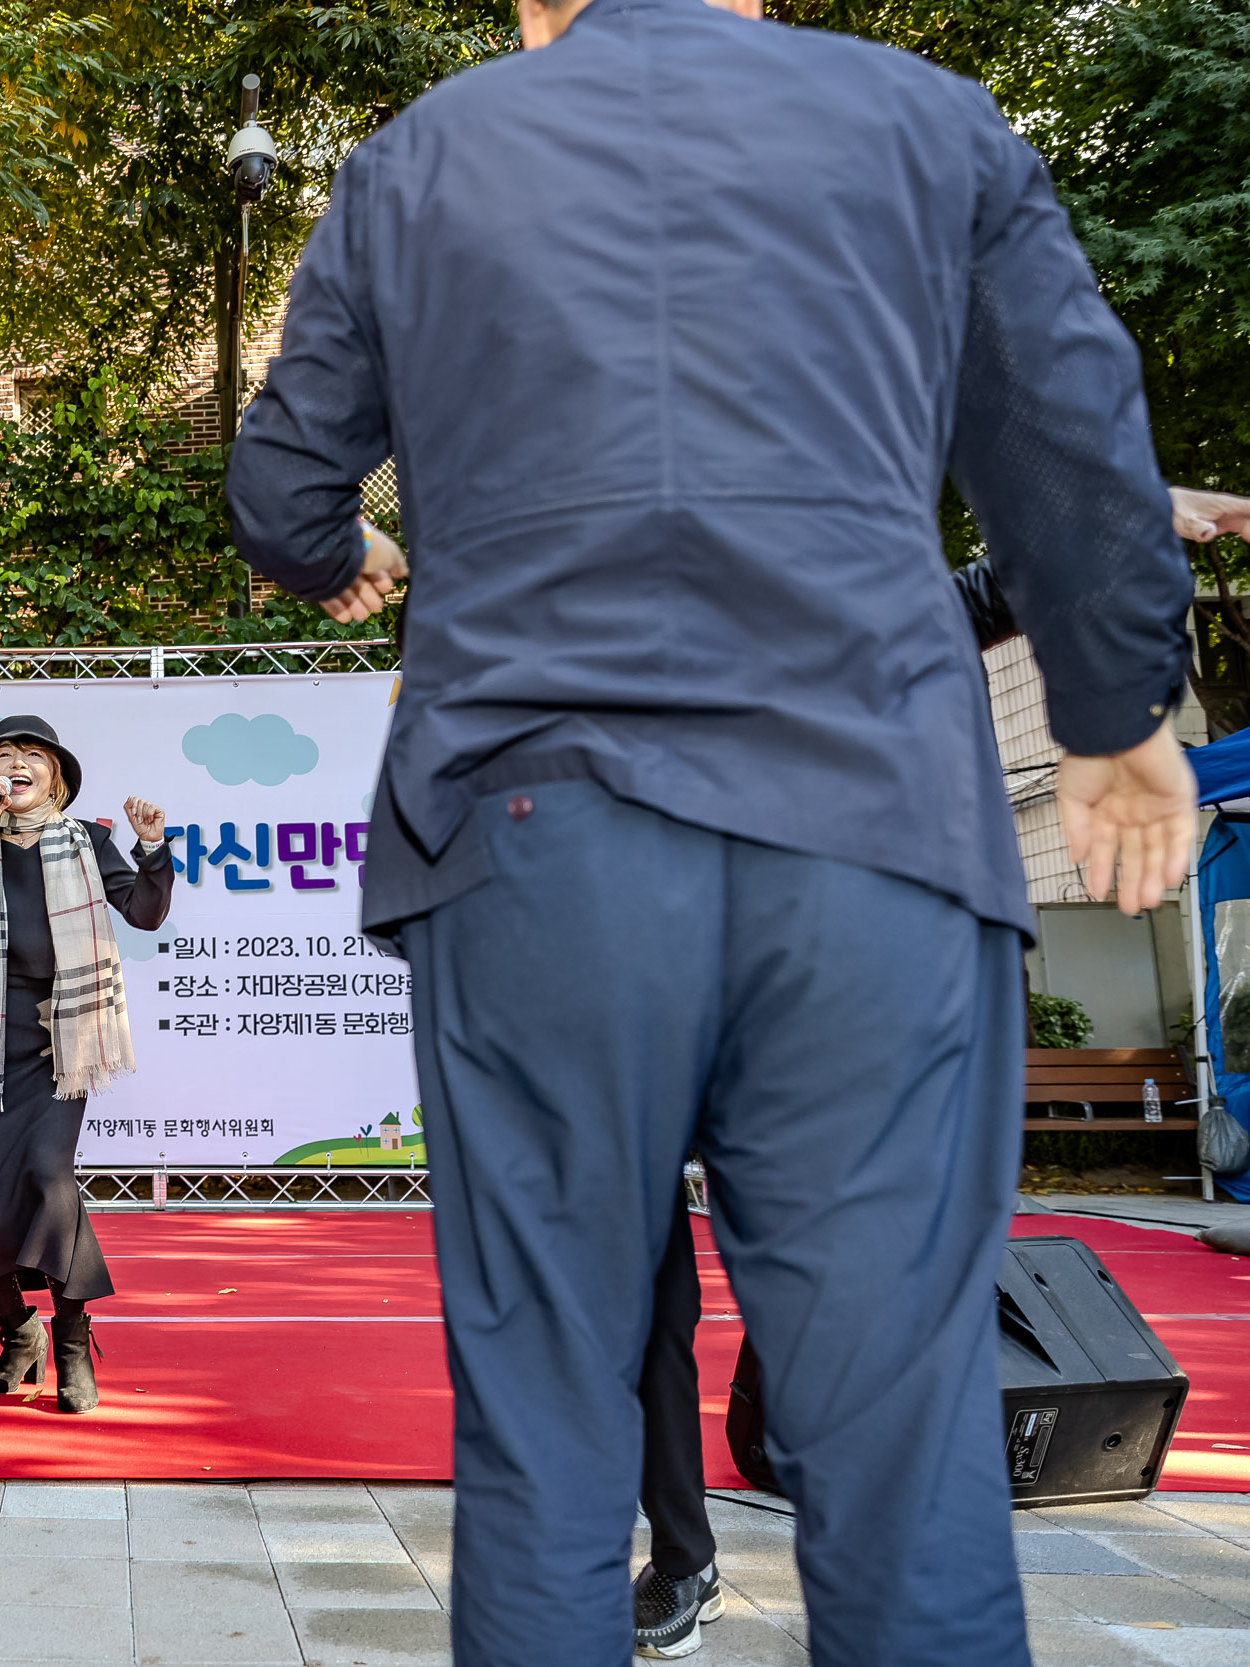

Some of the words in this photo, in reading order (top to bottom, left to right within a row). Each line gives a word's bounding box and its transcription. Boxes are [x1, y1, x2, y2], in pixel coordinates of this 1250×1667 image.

[173, 936, 217, 960] 일시
[236, 936, 300, 957] 2023.
[305, 936, 337, 957] 10.
[343, 936, 391, 958] 21.
[173, 974, 219, 998] 장소
[174, 1013, 219, 1036] 주관
[237, 1012, 337, 1036] 자양제1동
[343, 1012, 415, 1036] 문화행
[86, 1119, 156, 1138] 자양제1동
[164, 1118, 275, 1138] 문화행사위원회
